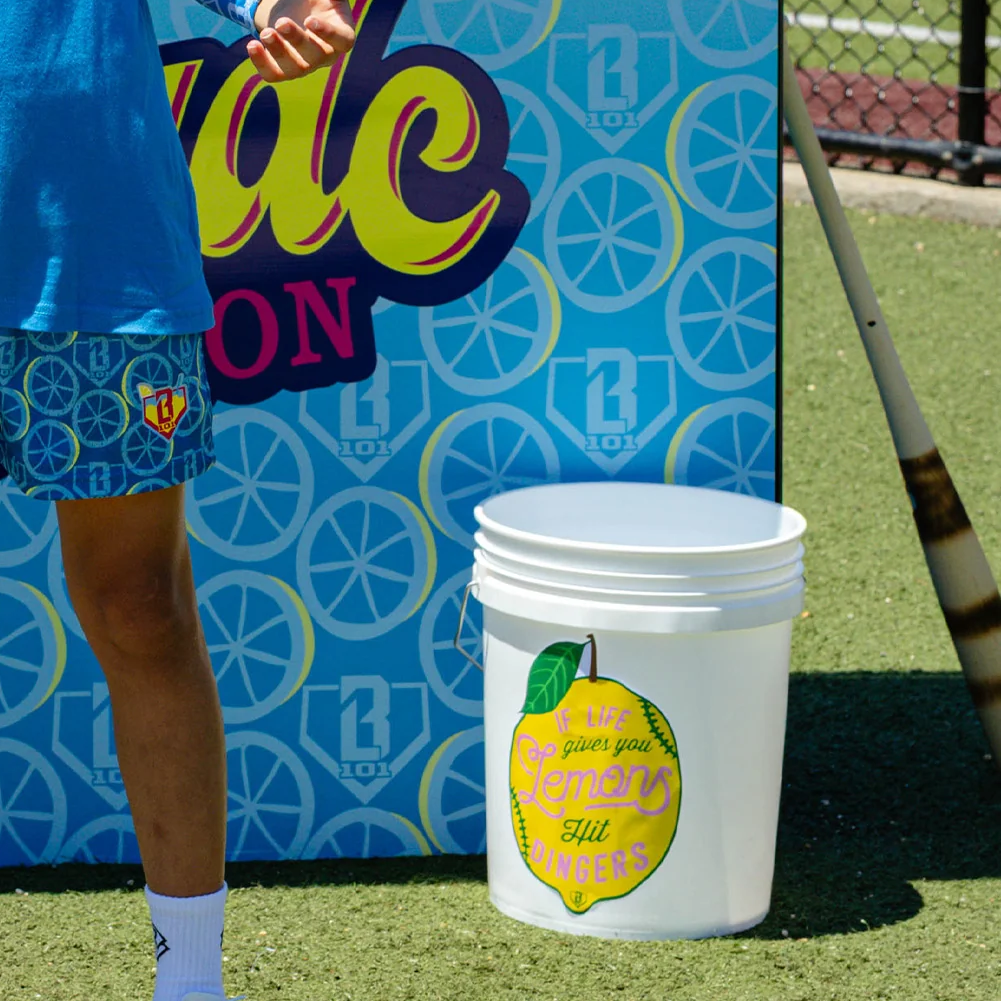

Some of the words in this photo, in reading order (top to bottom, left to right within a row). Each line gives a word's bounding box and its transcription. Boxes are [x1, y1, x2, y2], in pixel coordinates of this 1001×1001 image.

[585, 111, 639, 129] 101
[158, 422, 176, 432] 101
[339, 440, 391, 456] 101
[585, 434, 638, 452] 101
[554, 708, 571, 734] IF
[587, 705, 632, 732] LIFE
[563, 736, 611, 759] gives
[615, 738, 653, 758] you
[339, 761, 392, 778] 101
[516, 733, 673, 817] Lemons
[561, 818, 610, 847] Hit
[530, 838, 650, 884] DINGERS
